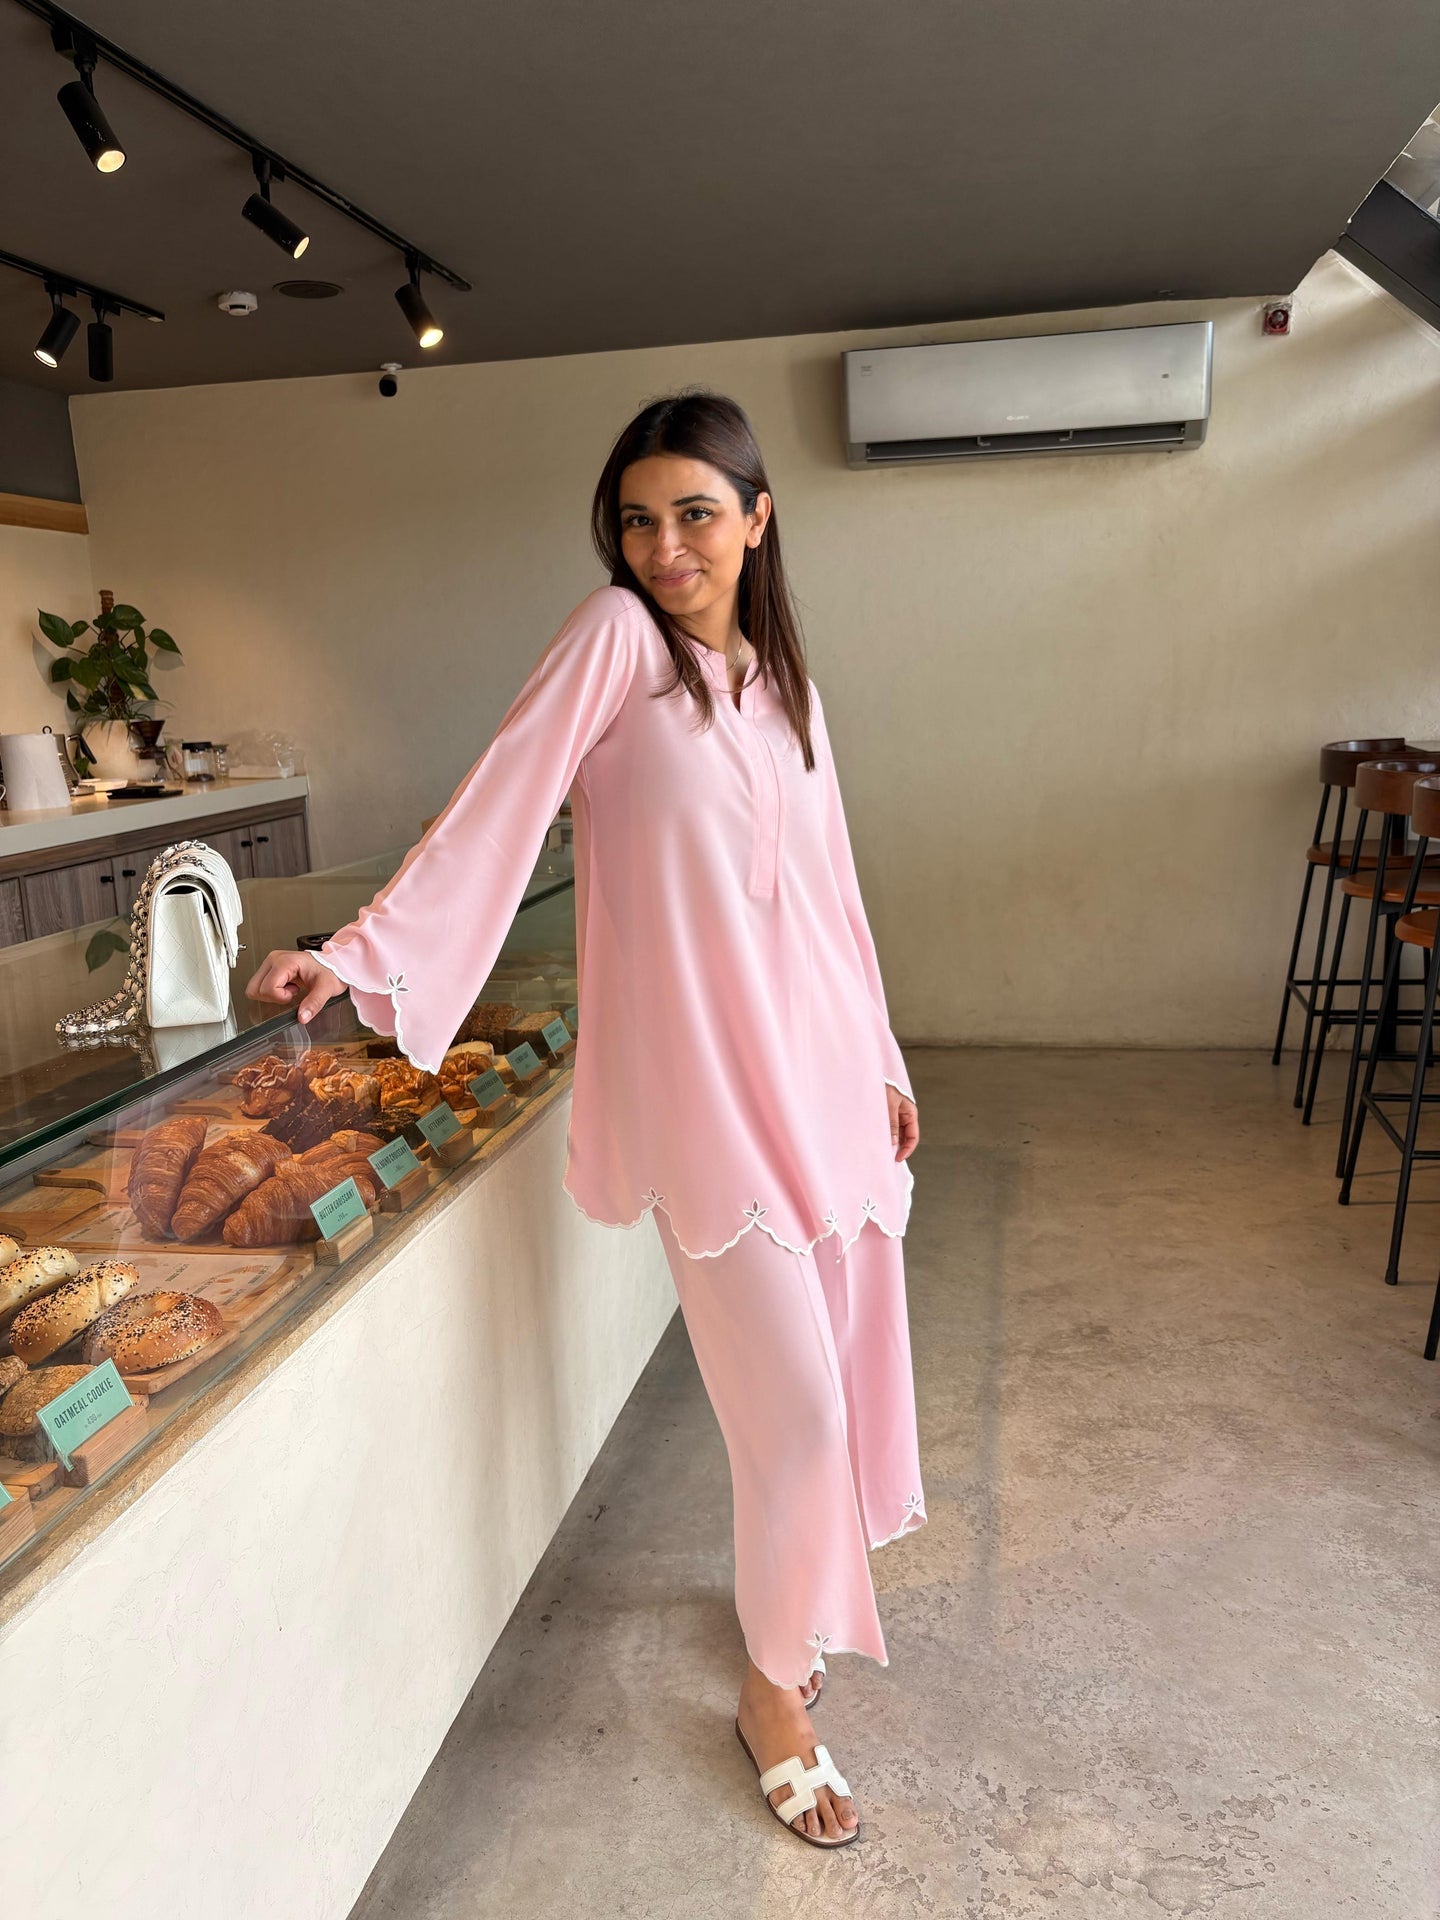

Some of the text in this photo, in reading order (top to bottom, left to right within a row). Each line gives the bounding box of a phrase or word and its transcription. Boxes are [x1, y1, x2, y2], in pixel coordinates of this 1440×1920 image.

[388, 1144, 409, 1162] CROISSANT
[318, 1188, 355, 1220] BUTTER CROISSANT
[54, 1377, 114, 1429] OATMEAL COOKIE
